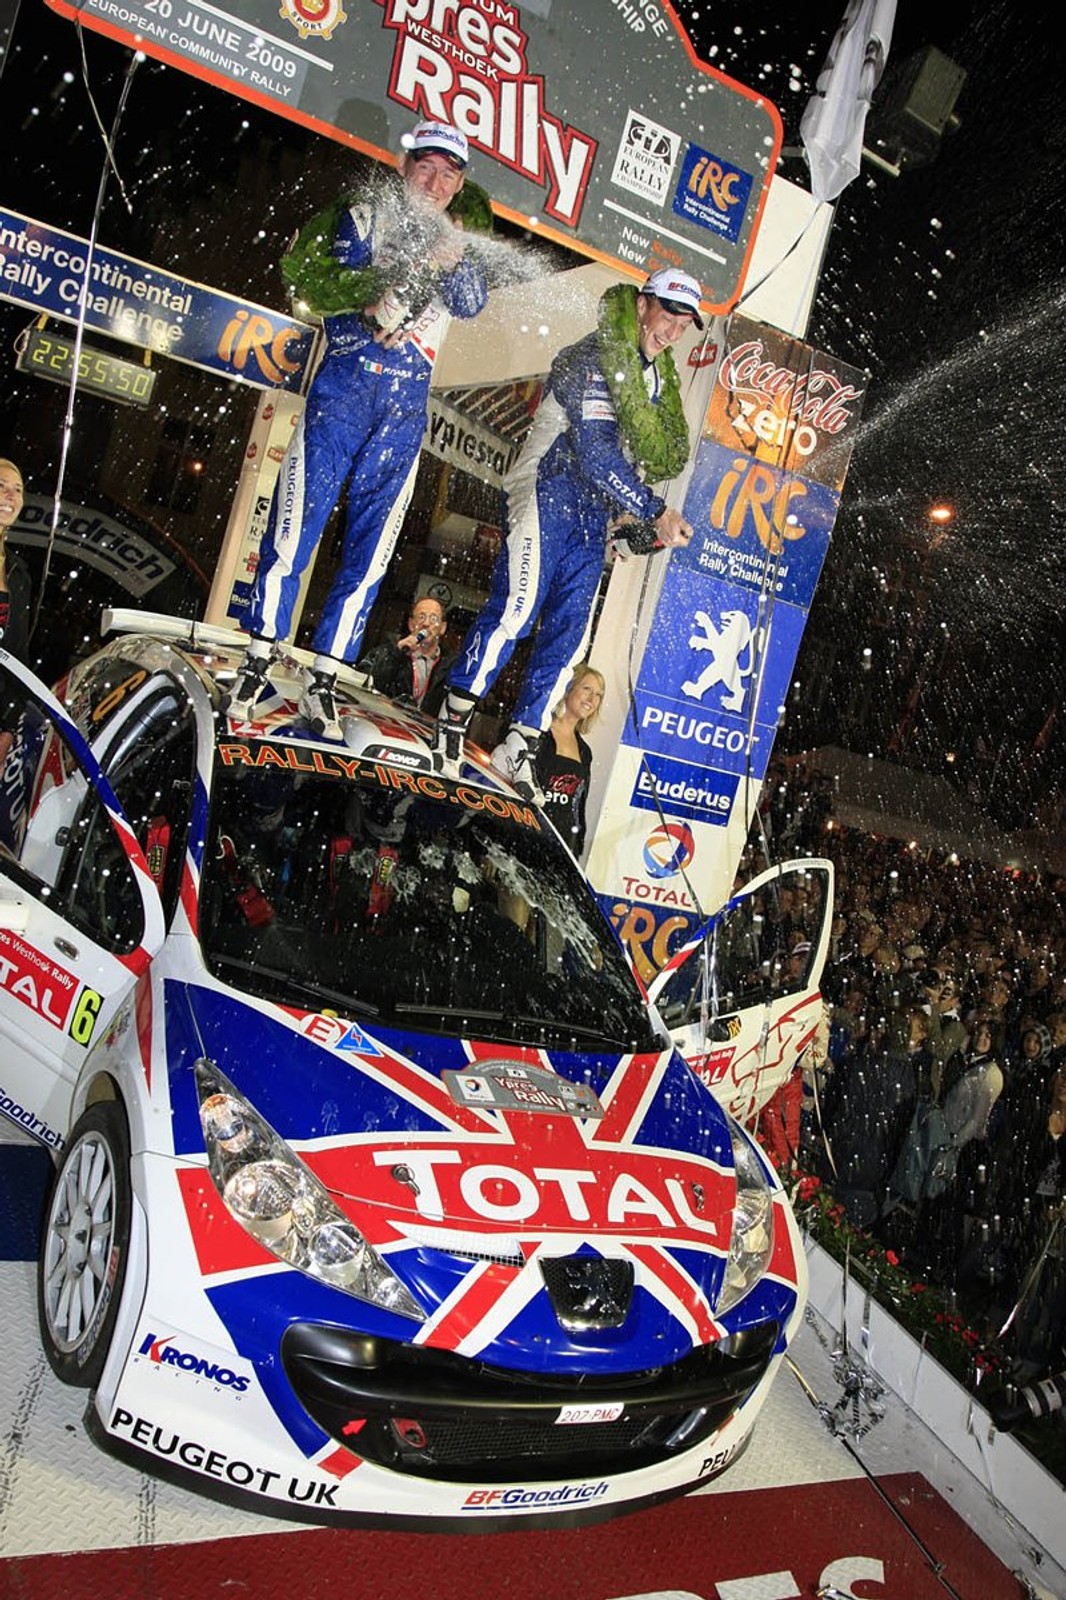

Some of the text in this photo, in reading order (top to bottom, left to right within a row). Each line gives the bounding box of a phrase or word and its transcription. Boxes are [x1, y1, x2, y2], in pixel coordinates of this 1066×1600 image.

[88, 0, 292, 98] EUROPEAN COMMUNITY RALLY
[144, 0, 297, 79] 20 JUNE 2009
[406, 18, 499, 83] WESTHOEK
[395, 37, 588, 220] Rally
[619, 159, 664, 192] RALLY
[683, 203, 699, 217] Rally
[684, 194, 732, 223] Intercontinental
[618, 243, 646, 265] New
[622, 226, 650, 249] New
[731, 398, 817, 455] zero
[284, 456, 298, 516] PEUGEOT
[607, 470, 645, 508] TOTAL
[514, 537, 533, 614] PEUGEOT UK
[699, 553, 728, 575] Rally
[642, 706, 760, 755] PEUGEOT
[377, 747, 421, 766] KRONOS
[218, 743, 542, 832] RALLY-IRC.COM
[637, 771, 731, 810] Buderus
[622, 876, 692, 907] TOTAL
[51, 967, 74, 990] Rally
[71, 988, 99, 1044] 6
[304, 1015, 336, 1043] E
[514, 1090, 567, 1112] Rally
[373, 1150, 718, 1236] TOTAL
[138, 1333, 251, 1392] KRONOS
[111, 1407, 340, 1506] PEUGEOT UK
[464, 1482, 609, 1506] BFGoodrich
